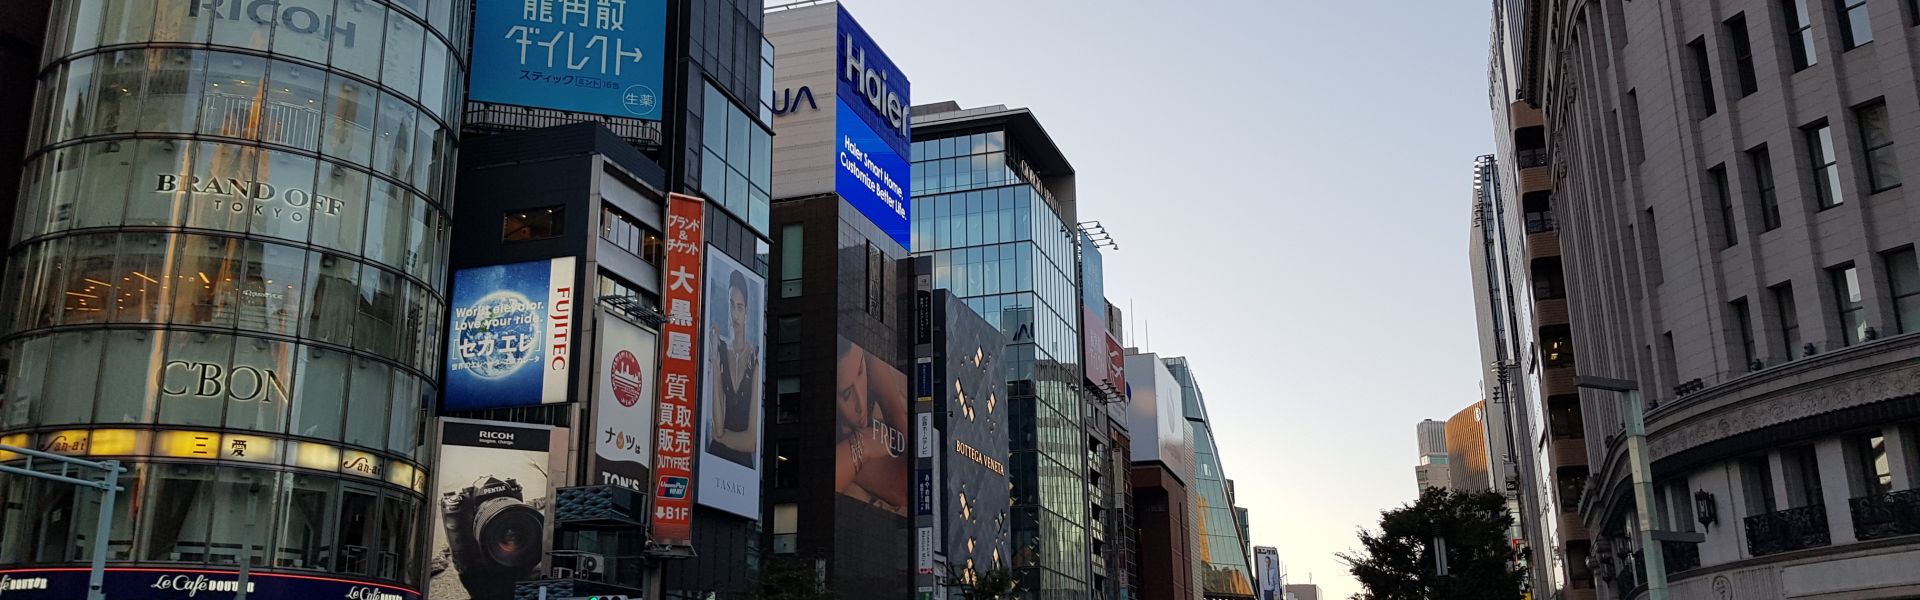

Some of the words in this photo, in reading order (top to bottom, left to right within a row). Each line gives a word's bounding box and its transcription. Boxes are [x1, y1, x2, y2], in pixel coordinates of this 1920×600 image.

[189, 0, 356, 48] RICOH
[504, 25, 643, 76] ダイレクト
[520, 70, 574, 85] スティック
[577, 78, 602, 88] ミント
[846, 33, 911, 137] Haier
[625, 92, 653, 107] 生薬
[844, 134, 863, 160] Haier
[863, 153, 884, 181] Smart
[883, 171, 904, 200] Home,
[156, 174, 276, 200] BRAND
[284, 188, 345, 216] OFF
[840, 152, 876, 194] Customize
[876, 183, 896, 209] Better
[895, 198, 907, 221] Life.
[214, 200, 303, 222] TOKYO
[669, 215, 700, 232] ブランド
[679, 230, 688, 240] &
[667, 239, 699, 256] チケット
[455, 319, 482, 331] Love
[484, 316, 512, 329] your
[514, 313, 543, 325] ride.
[667, 265, 695, 361] 大黒屋
[550, 287, 570, 370] FUJITEC
[156, 360, 288, 402] C'BON
[665, 373, 690, 402] 質
[660, 403, 691, 428] 買取
[479, 430, 514, 440] RICOH
[658, 428, 691, 453] 販売
[872, 418, 905, 458] FRED
[956, 440, 983, 466] BOTTEGA
[983, 455, 1005, 476] VENETA
[483, 486, 505, 494] PENTAX
[602, 472, 640, 491] TON'S
[714, 476, 744, 496] TASAKI
[666, 507, 688, 520] B1F
[150, 574, 171, 589] Le
[172, 574, 209, 597] Café
[208, 580, 255, 593] DOUTR
[344, 586, 360, 599] Le
